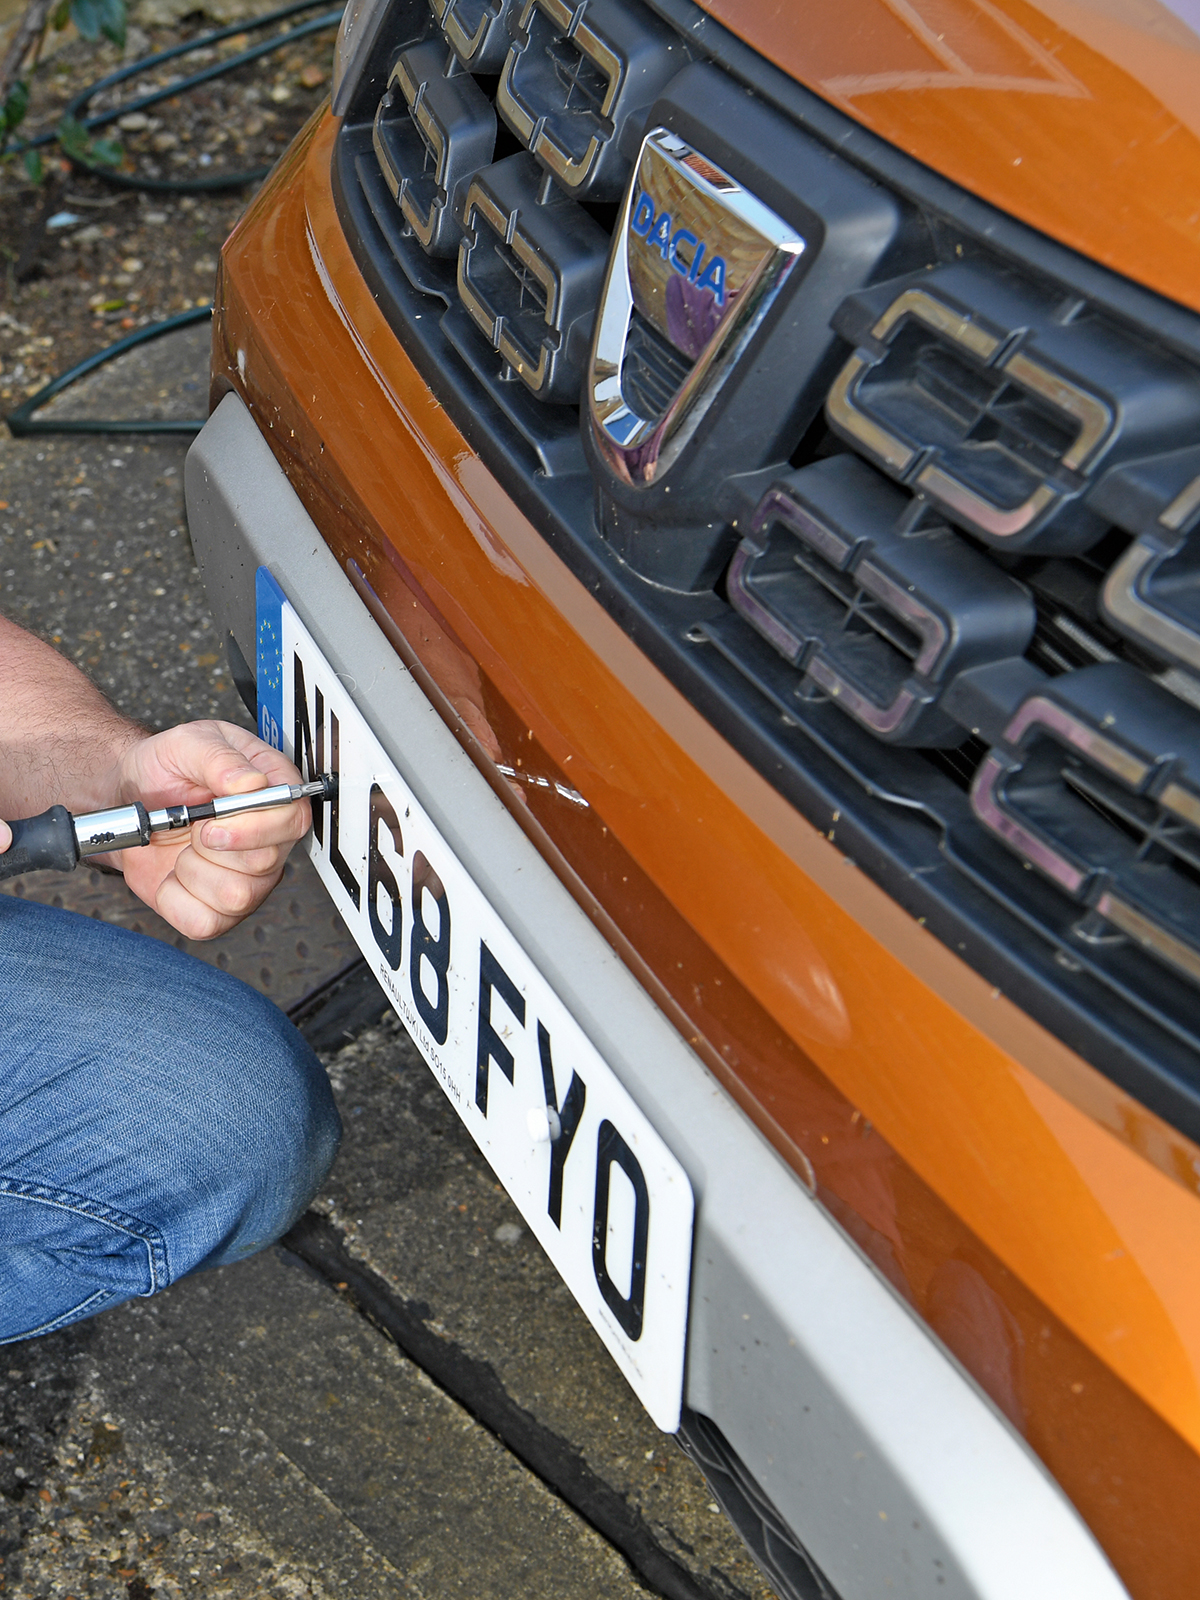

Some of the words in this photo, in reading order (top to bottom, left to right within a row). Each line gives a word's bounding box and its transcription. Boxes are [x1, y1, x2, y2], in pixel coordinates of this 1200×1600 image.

[631, 191, 726, 306] DACIA
[293, 650, 451, 1046] NL68
[419, 1029, 431, 1052] Ltd
[430, 1047, 447, 1080] SO15
